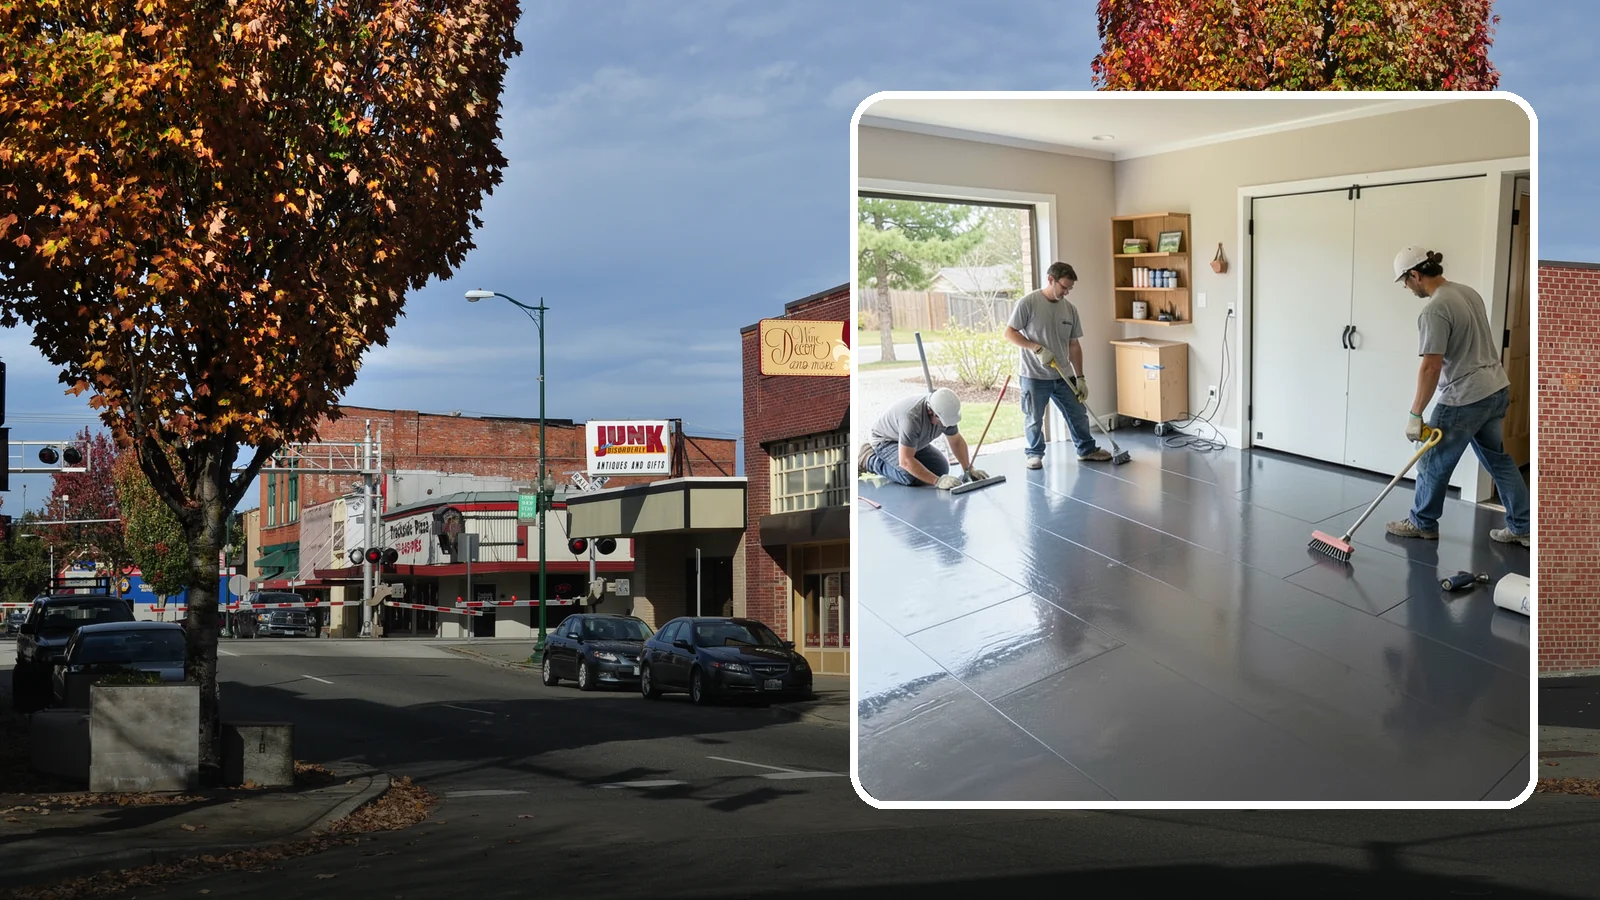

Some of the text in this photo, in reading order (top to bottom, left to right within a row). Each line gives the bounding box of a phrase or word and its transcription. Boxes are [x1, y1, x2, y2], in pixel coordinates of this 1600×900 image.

[765, 328, 831, 365] Decor
[595, 425, 665, 457] JUNK
[608, 446, 646, 454] DISORDERLY
[596, 460, 665, 470] ANTIQUES AND GIFTS
[390, 519, 429, 539] Trackside Pizza
